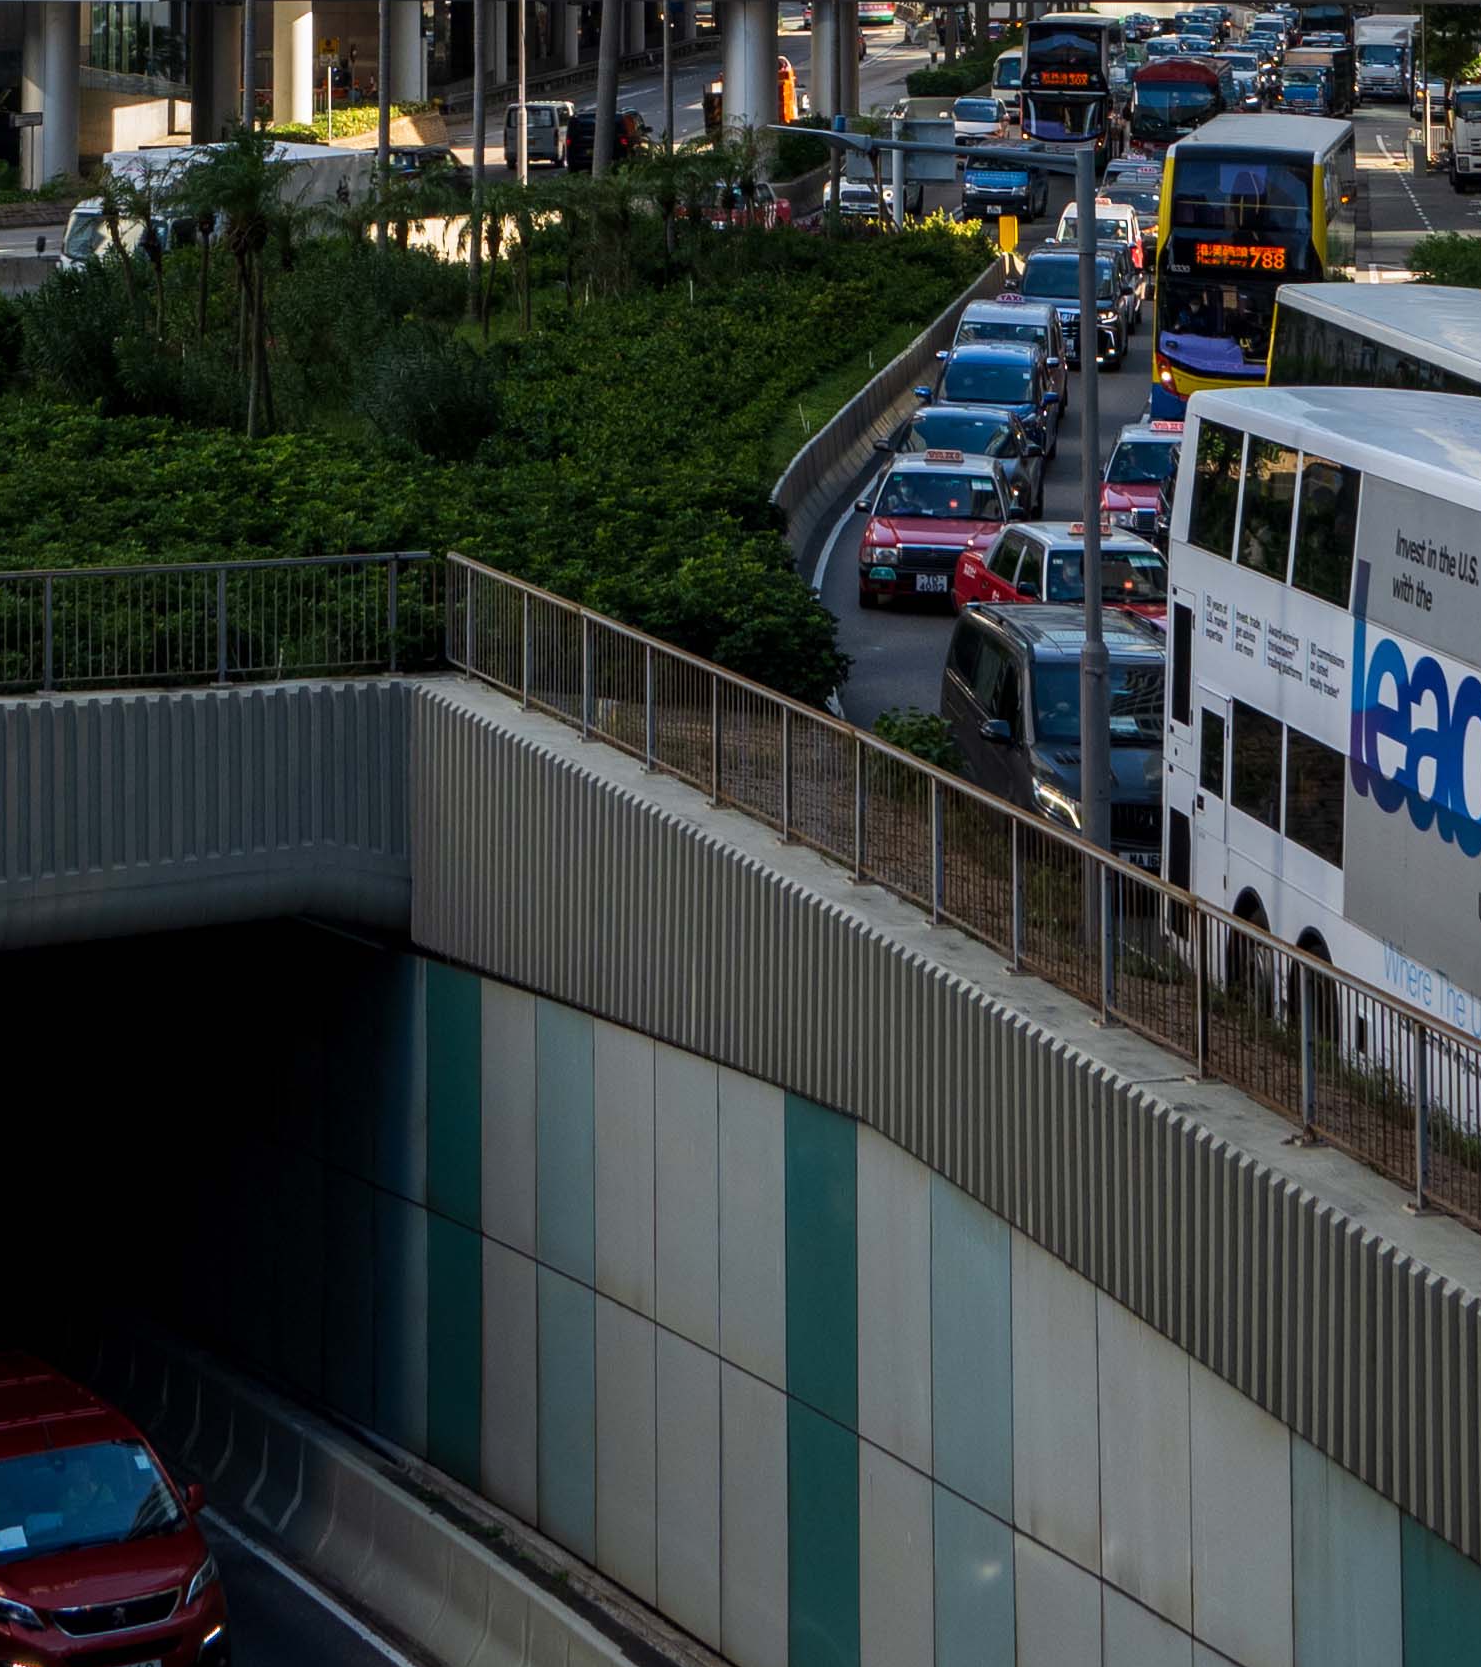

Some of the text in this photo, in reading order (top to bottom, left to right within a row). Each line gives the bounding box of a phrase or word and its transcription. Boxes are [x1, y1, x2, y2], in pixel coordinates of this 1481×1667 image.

[1250, 252, 1285, 269] 788
[1000, 294, 1022, 302] TAXI
[1395, 528, 1479, 586] Invest in the U.S.
[1392, 573, 1432, 612] with the
[1383, 937, 1432, 1007] Where
[1436, 969, 1465, 1028] The
